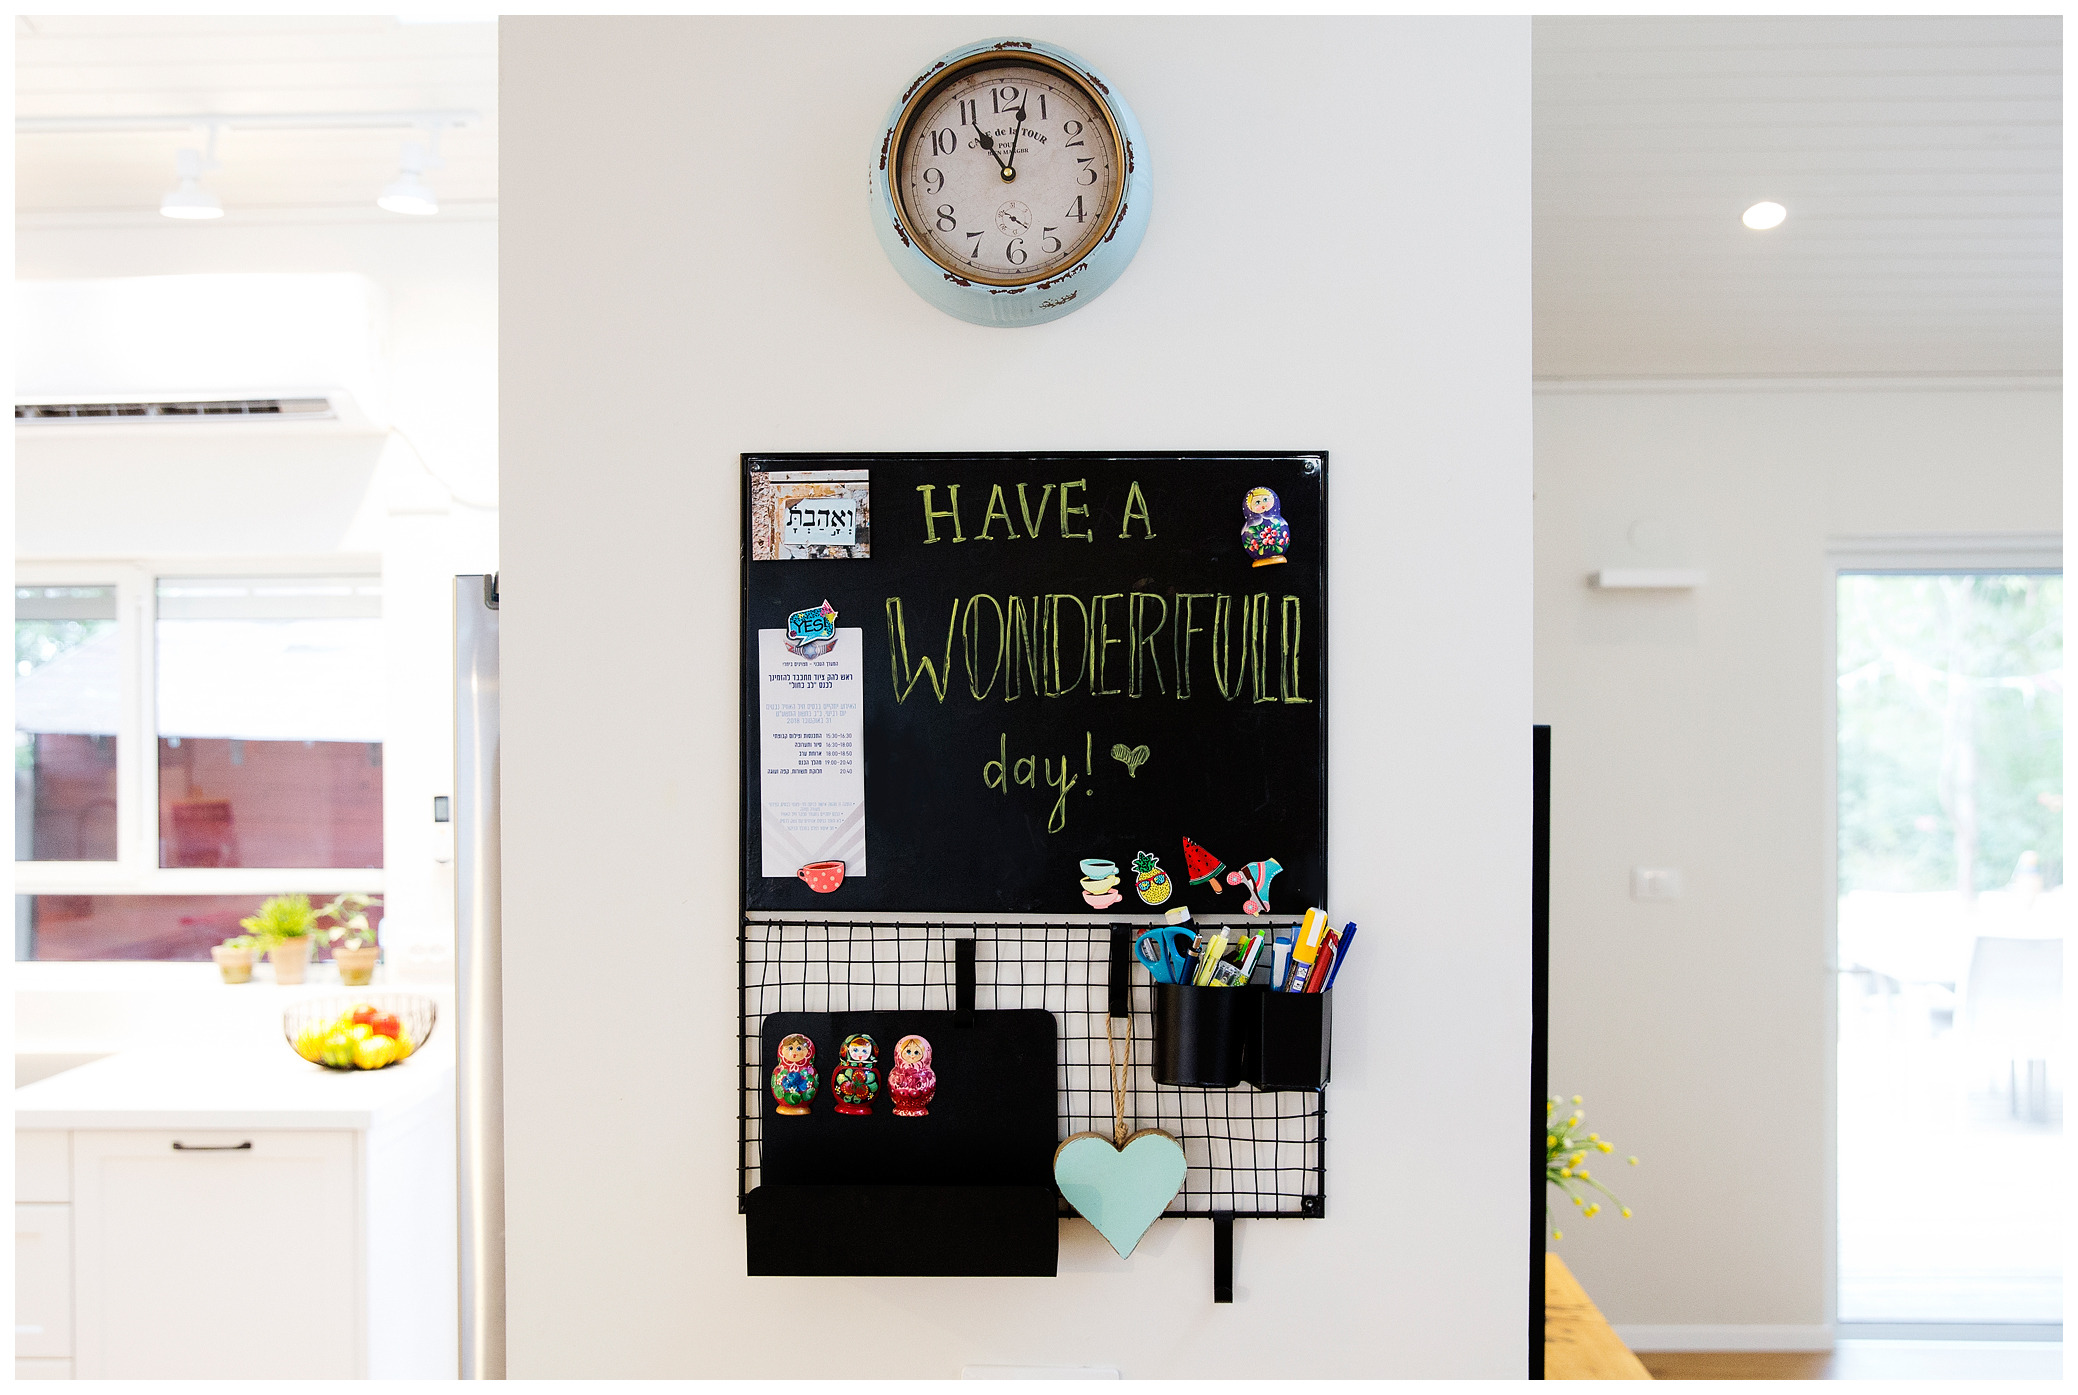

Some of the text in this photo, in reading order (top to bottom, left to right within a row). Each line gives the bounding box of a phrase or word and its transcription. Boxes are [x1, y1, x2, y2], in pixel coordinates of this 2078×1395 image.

[956, 99, 977, 126] 11
[989, 86, 1020, 114] 12
[1037, 94, 1048, 120] 1
[931, 128, 957, 156] 10
[968, 131, 993, 149] CAE
[995, 129, 1006, 137] de
[1022, 128, 1048, 145] TOUR
[1063, 120, 1085, 148] 2
[923, 168, 944, 194] 9
[1076, 157, 1098, 185] 3
[936, 204, 957, 232] 8
[1065, 196, 1087, 223] 4
[966, 230, 984, 258] 7
[1006, 238, 1027, 265] 6
[1042, 227, 1062, 253] 5
[916, 479, 1157, 545] HAVE A
[793, 619, 827, 633] YES!
[885, 592, 1313, 704] WONDERFULL
[768, 674, 790, 682] להזמינך
[792, 674, 812, 682] מתכבד
[841, 674, 853, 682] ראש
[983, 731, 1095, 834] day!
